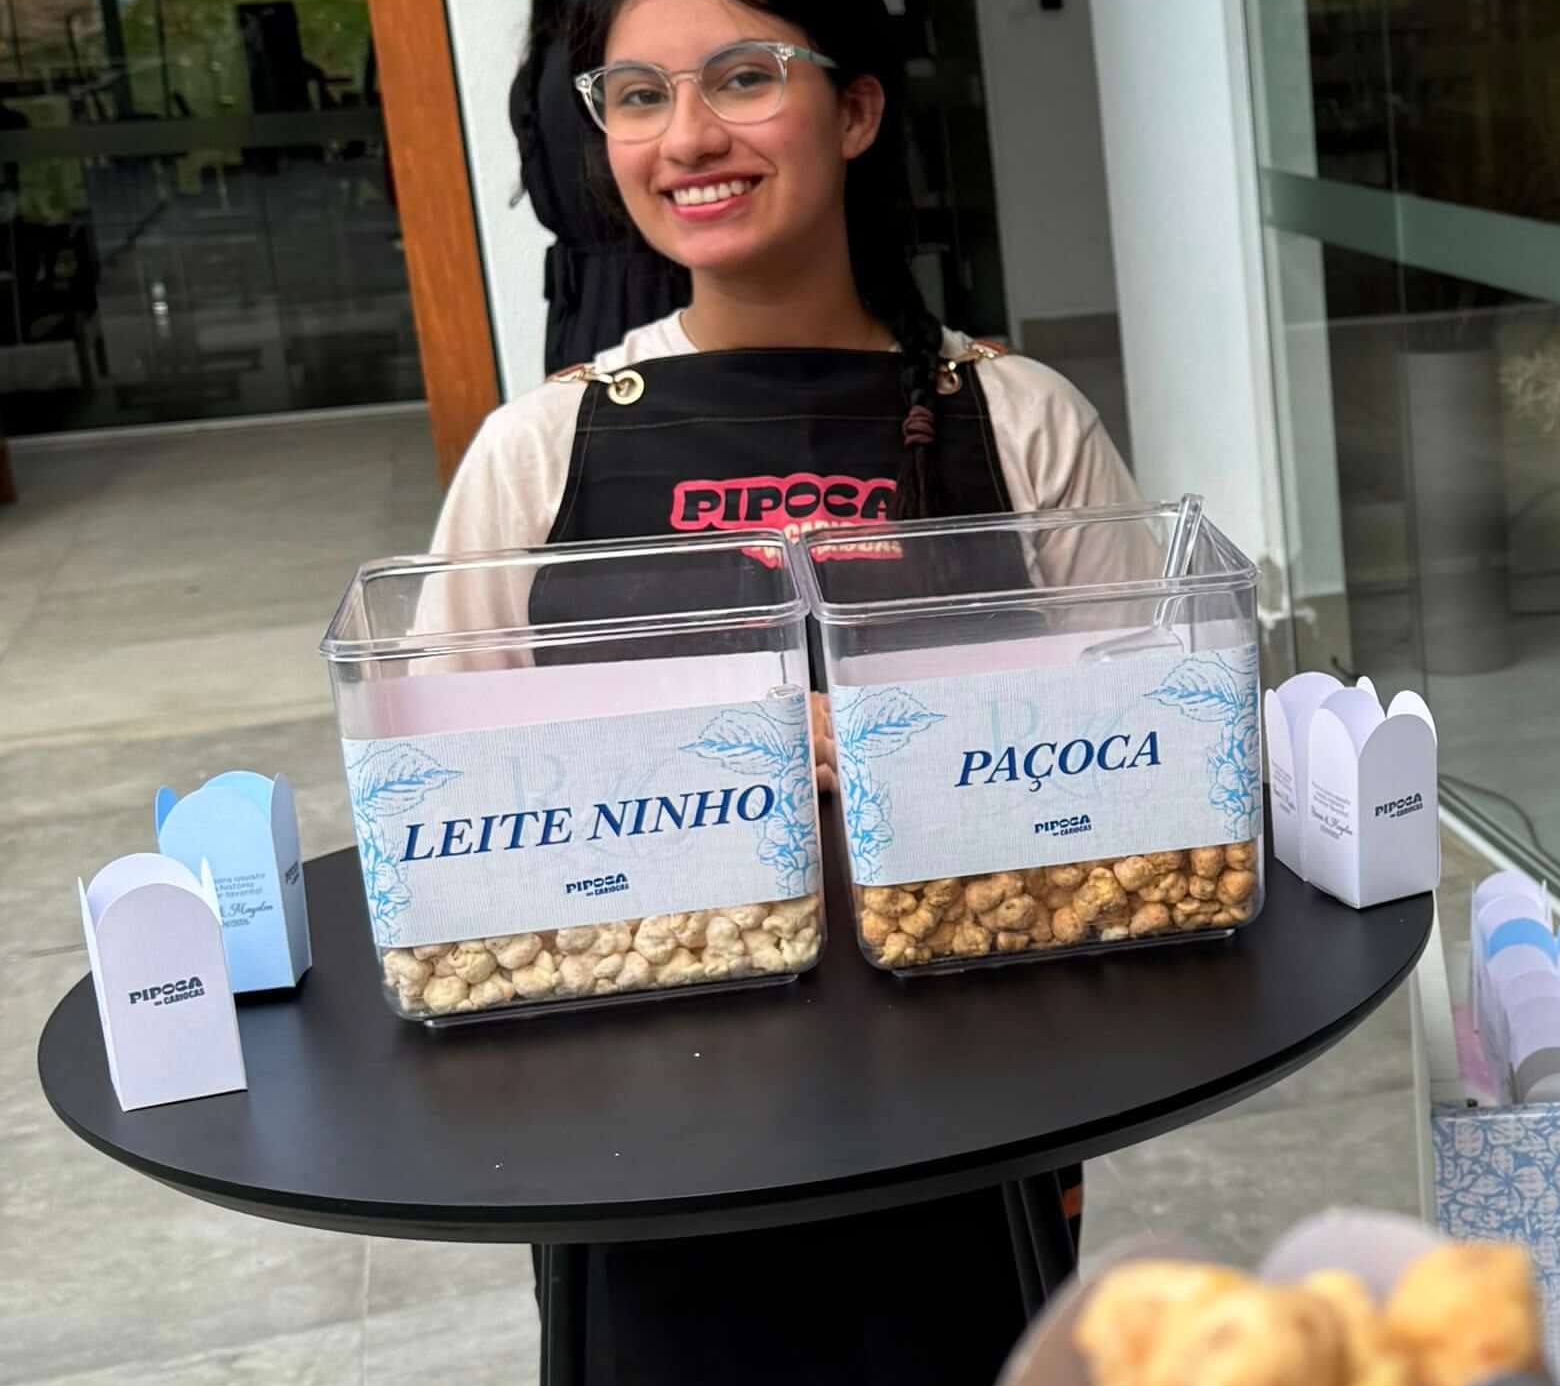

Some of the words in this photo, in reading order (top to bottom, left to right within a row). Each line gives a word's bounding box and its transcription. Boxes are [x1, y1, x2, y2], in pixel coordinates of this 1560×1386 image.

[681, 482, 897, 522] PIPOCA
[954, 730, 1162, 793] PAÇOCA
[1375, 792, 1422, 817] PIPOCA
[401, 801, 573, 862] LEITE
[589, 784, 775, 841] NINHO
[1034, 814, 1091, 833] PIPOCA
[566, 872, 628, 894] PIPOCA
[128, 976, 203, 1005] PIPOCA
